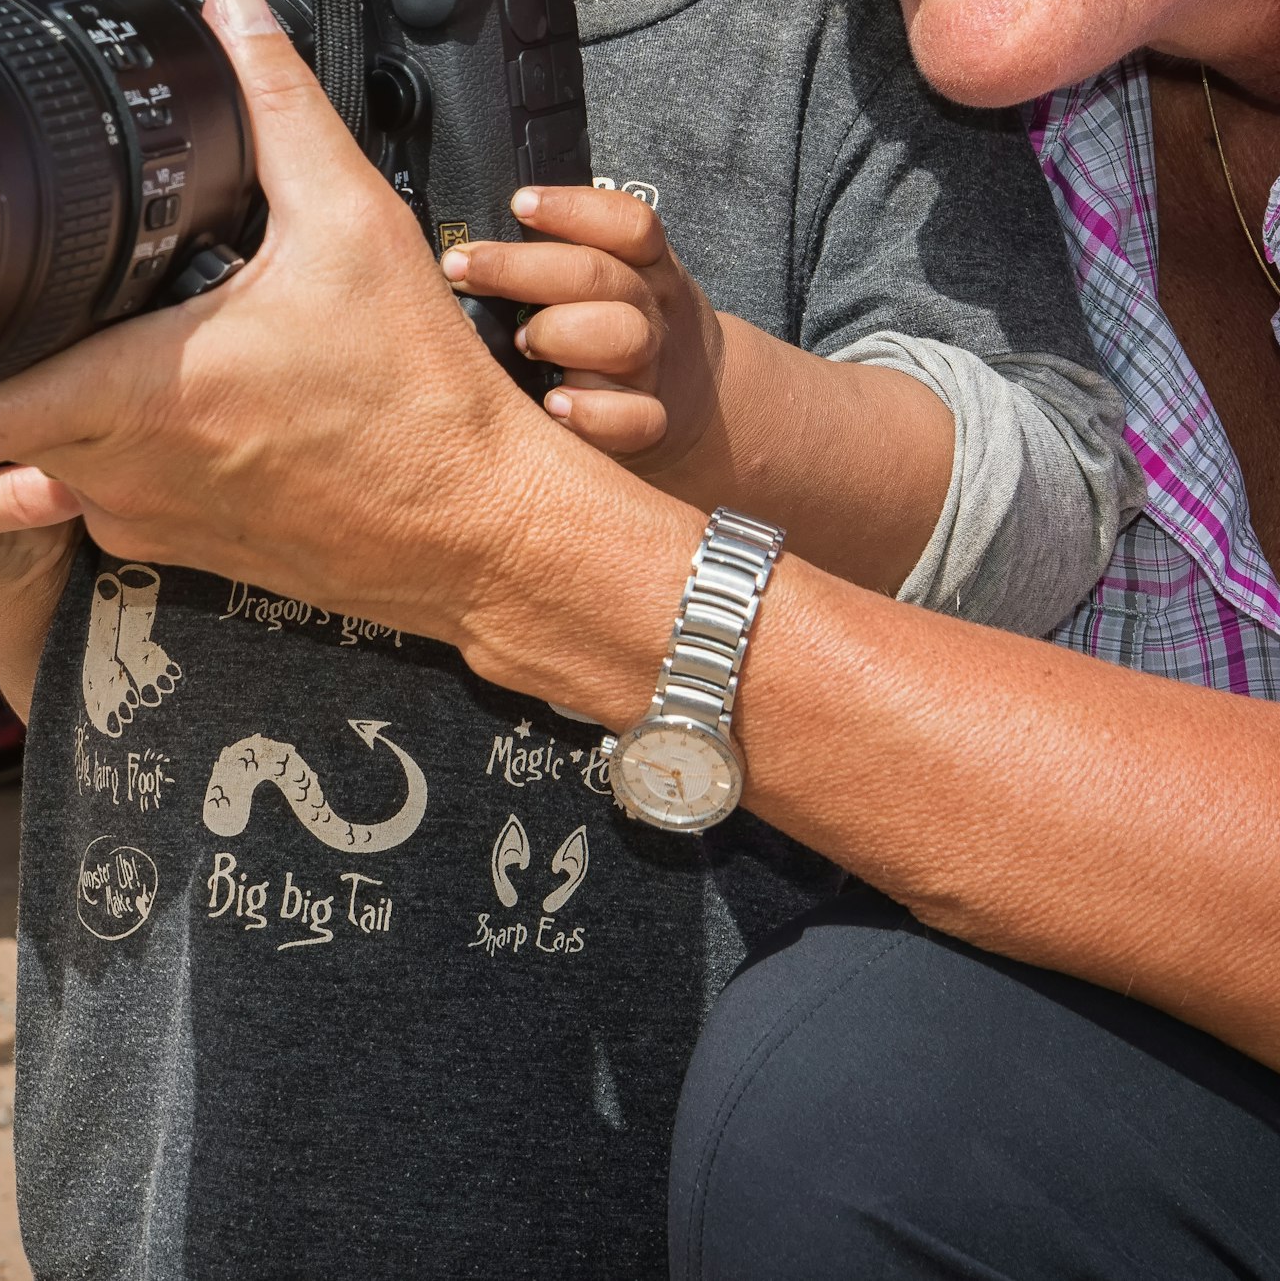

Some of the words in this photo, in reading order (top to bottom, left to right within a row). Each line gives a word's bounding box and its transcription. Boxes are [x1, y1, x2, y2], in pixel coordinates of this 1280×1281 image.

[443, 228, 466, 247] FX
[486, 735, 564, 787] Magic
[207, 852, 269, 930] Big
[277, 872, 334, 951] big
[340, 872, 392, 933] Tail
[468, 914, 527, 957] Sharp
[535, 918, 585, 953] Ears
